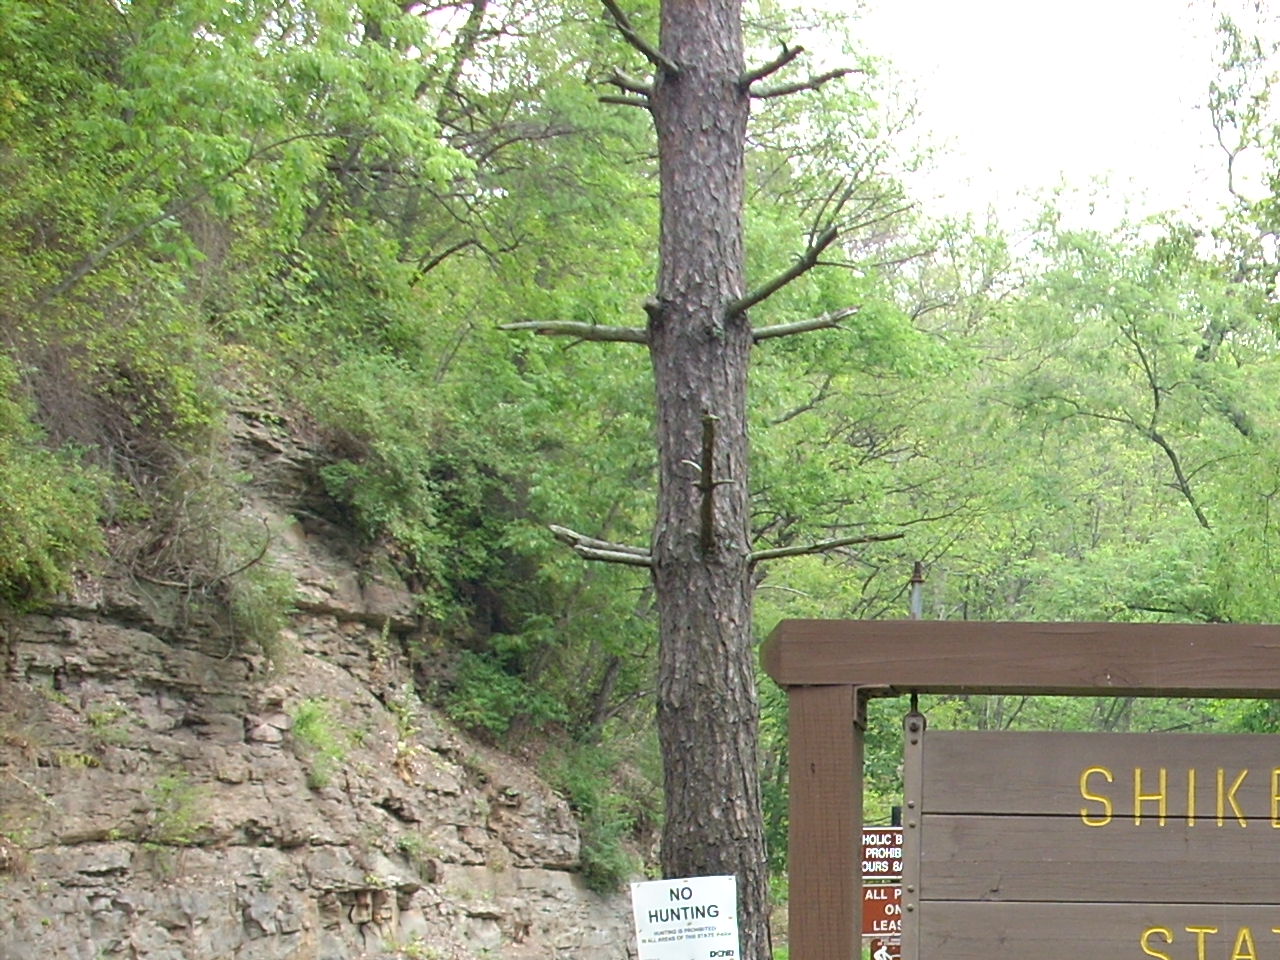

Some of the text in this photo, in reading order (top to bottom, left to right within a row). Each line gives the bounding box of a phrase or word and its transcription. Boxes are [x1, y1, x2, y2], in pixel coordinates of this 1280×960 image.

[669, 887, 693, 901] NO
[865, 888, 888, 900] ALL
[648, 904, 720, 924] HUNTING
